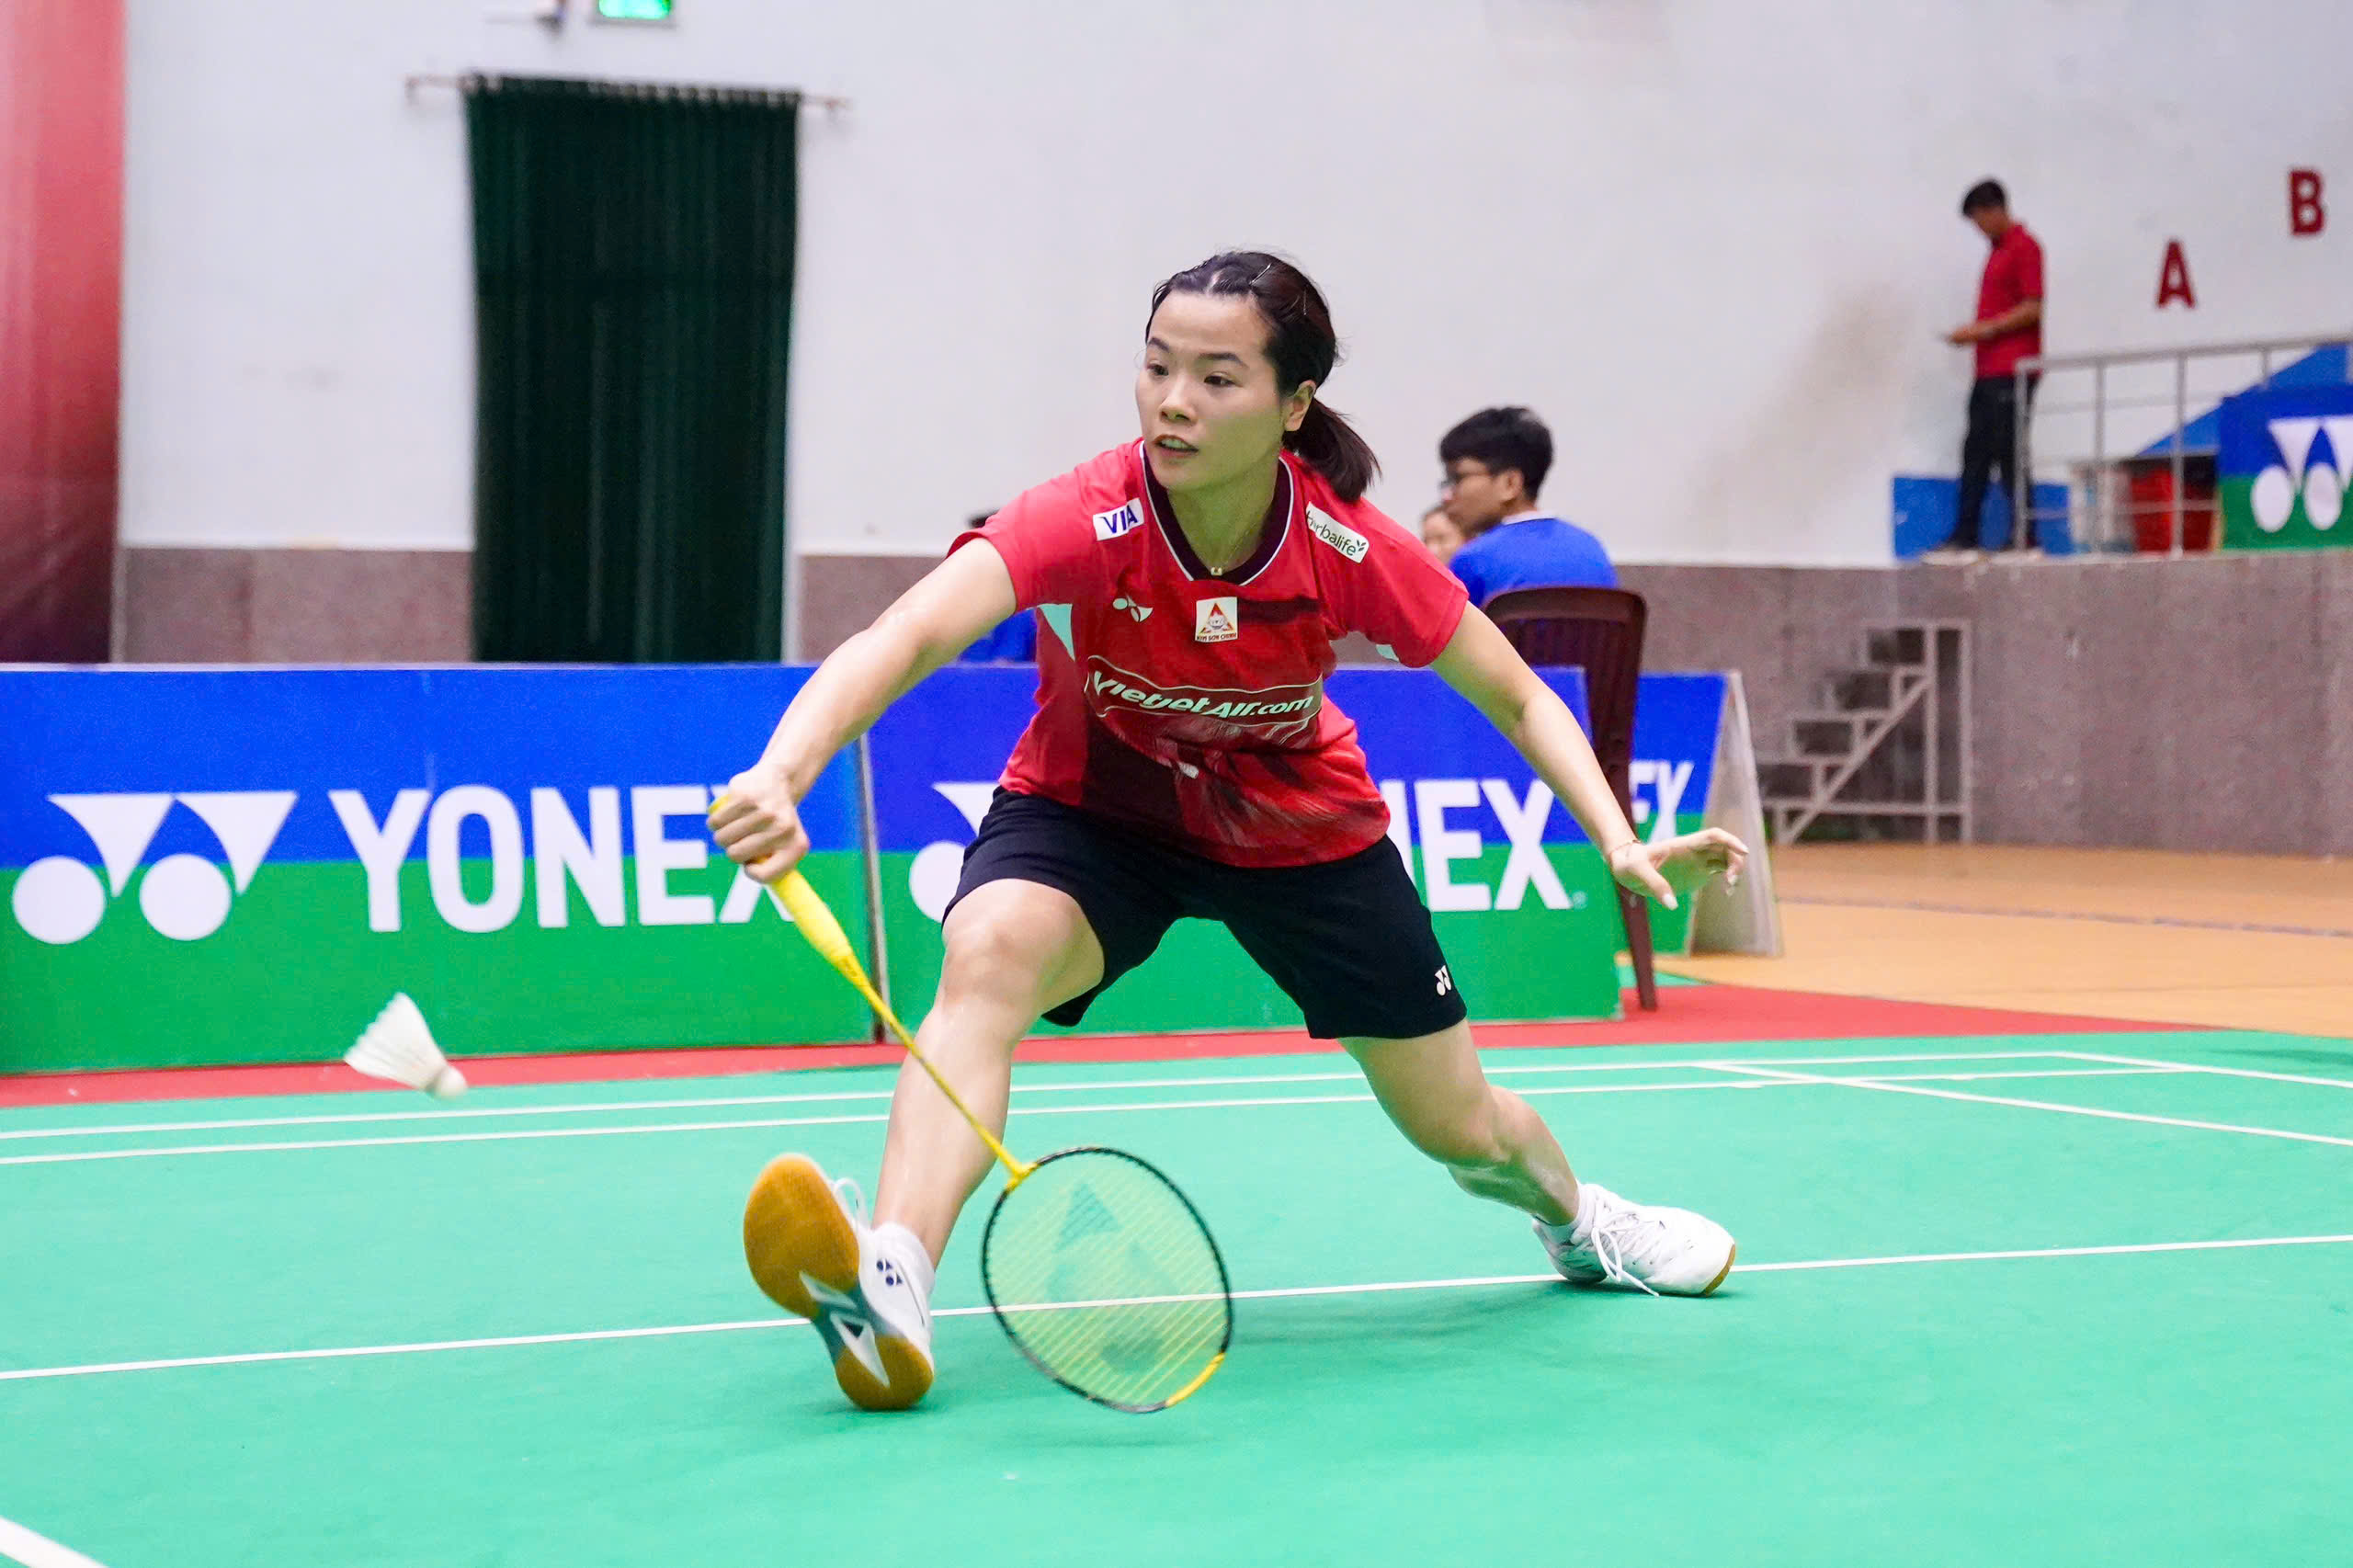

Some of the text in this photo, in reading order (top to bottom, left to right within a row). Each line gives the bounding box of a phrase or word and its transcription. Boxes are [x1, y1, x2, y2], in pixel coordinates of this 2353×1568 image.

[2290, 169, 2325, 236] B
[2156, 241, 2197, 310] A
[1099, 506, 1138, 534] VIA
